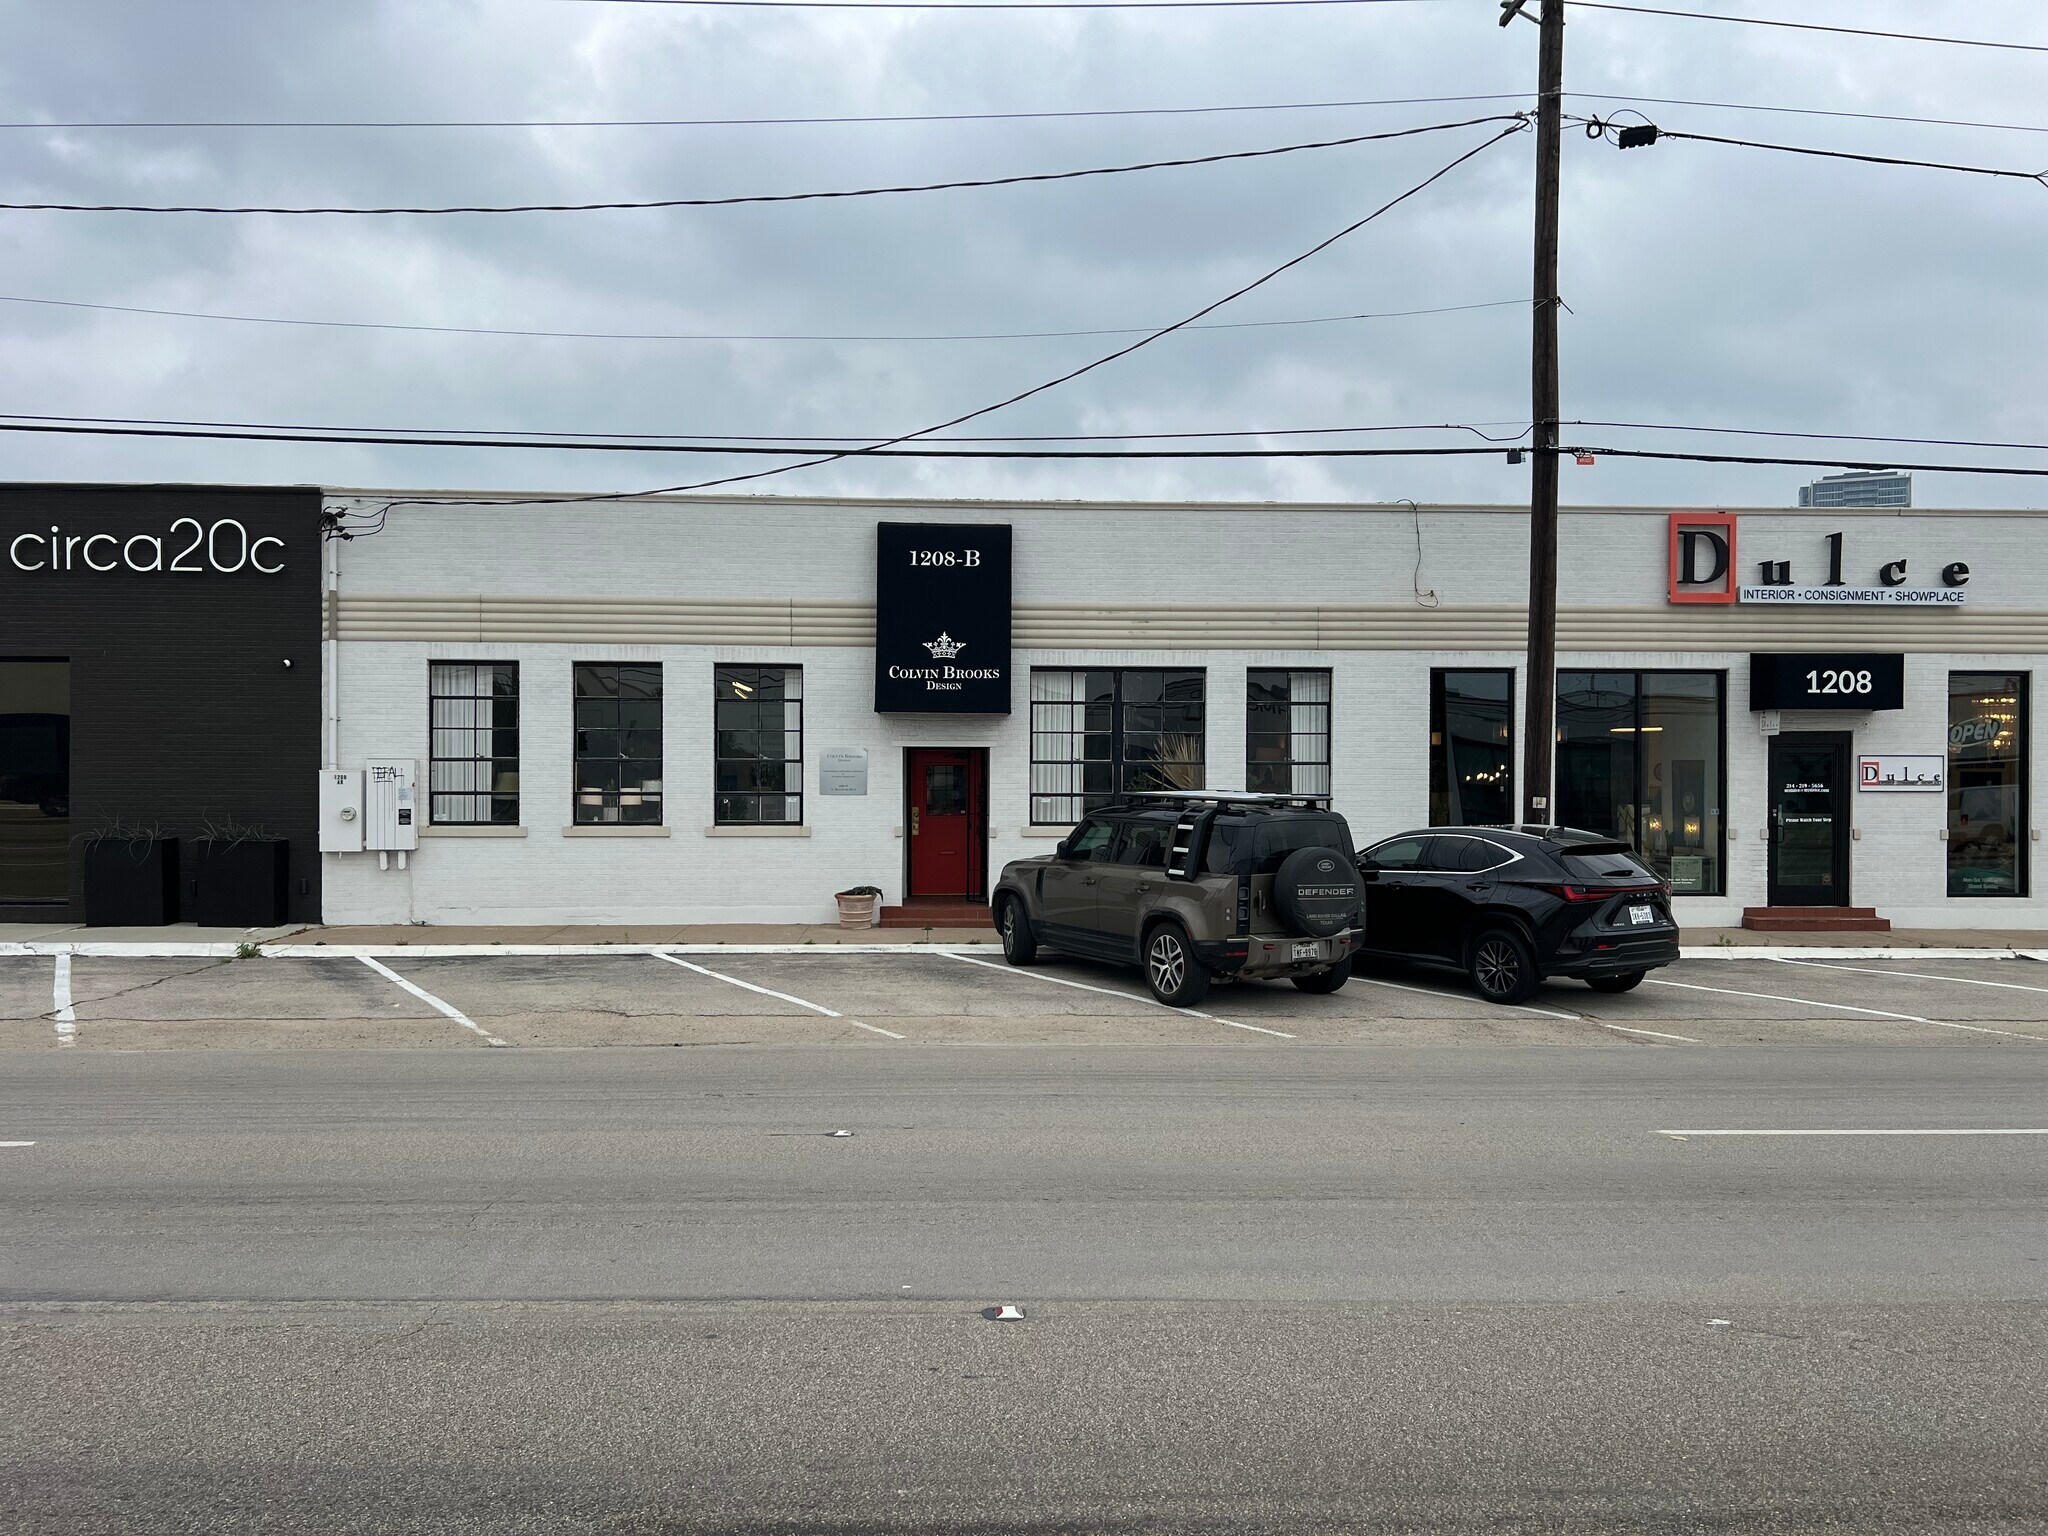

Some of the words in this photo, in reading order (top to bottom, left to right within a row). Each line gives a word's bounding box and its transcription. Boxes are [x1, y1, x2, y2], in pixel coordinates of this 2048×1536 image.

[10, 517, 285, 574] circa20c
[909, 549, 980, 567] 1208-B
[1677, 530, 1969, 587] Dulce
[1743, 589, 1795, 600] INTERIOR
[1804, 589, 1886, 601] CONSIGNMENT
[1894, 591, 1964, 602] SHOWPLACE
[888, 664, 939, 680] COLVIN
[943, 665, 1000, 680] BROOKS
[926, 680, 962, 691] DESIGN
[1806, 670, 1873, 694] 1208
[1950, 720, 1999, 744] OPEN
[1863, 766, 1941, 781] Dulce
[1298, 888, 1354, 896] DEFENDER
